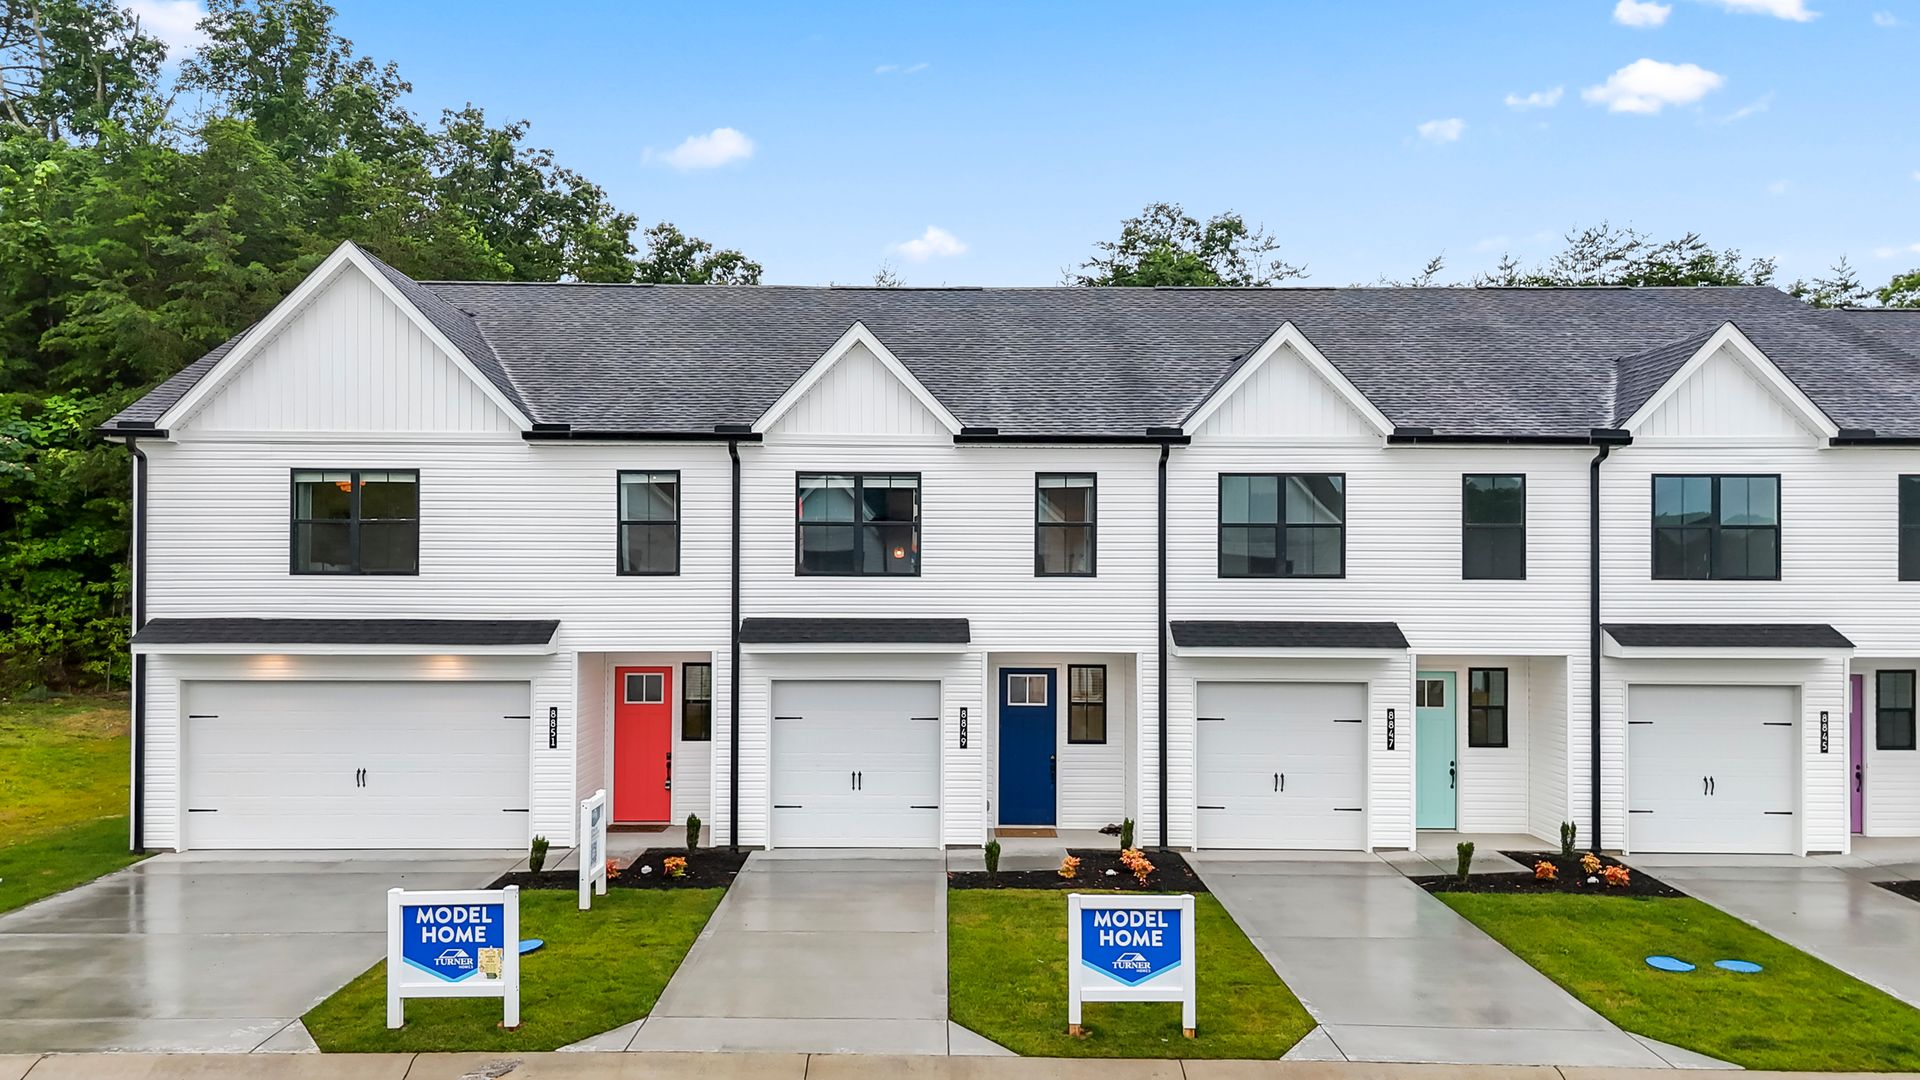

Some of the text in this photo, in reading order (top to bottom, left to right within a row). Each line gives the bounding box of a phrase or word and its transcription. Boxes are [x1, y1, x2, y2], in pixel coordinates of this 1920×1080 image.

[416, 906, 493, 924] MODEL
[1093, 910, 1169, 928] MODEL
[421, 925, 487, 944] HOME
[1099, 929, 1163, 947] HOME
[434, 958, 474, 966] TURNER
[1111, 961, 1151, 969] TURNER
